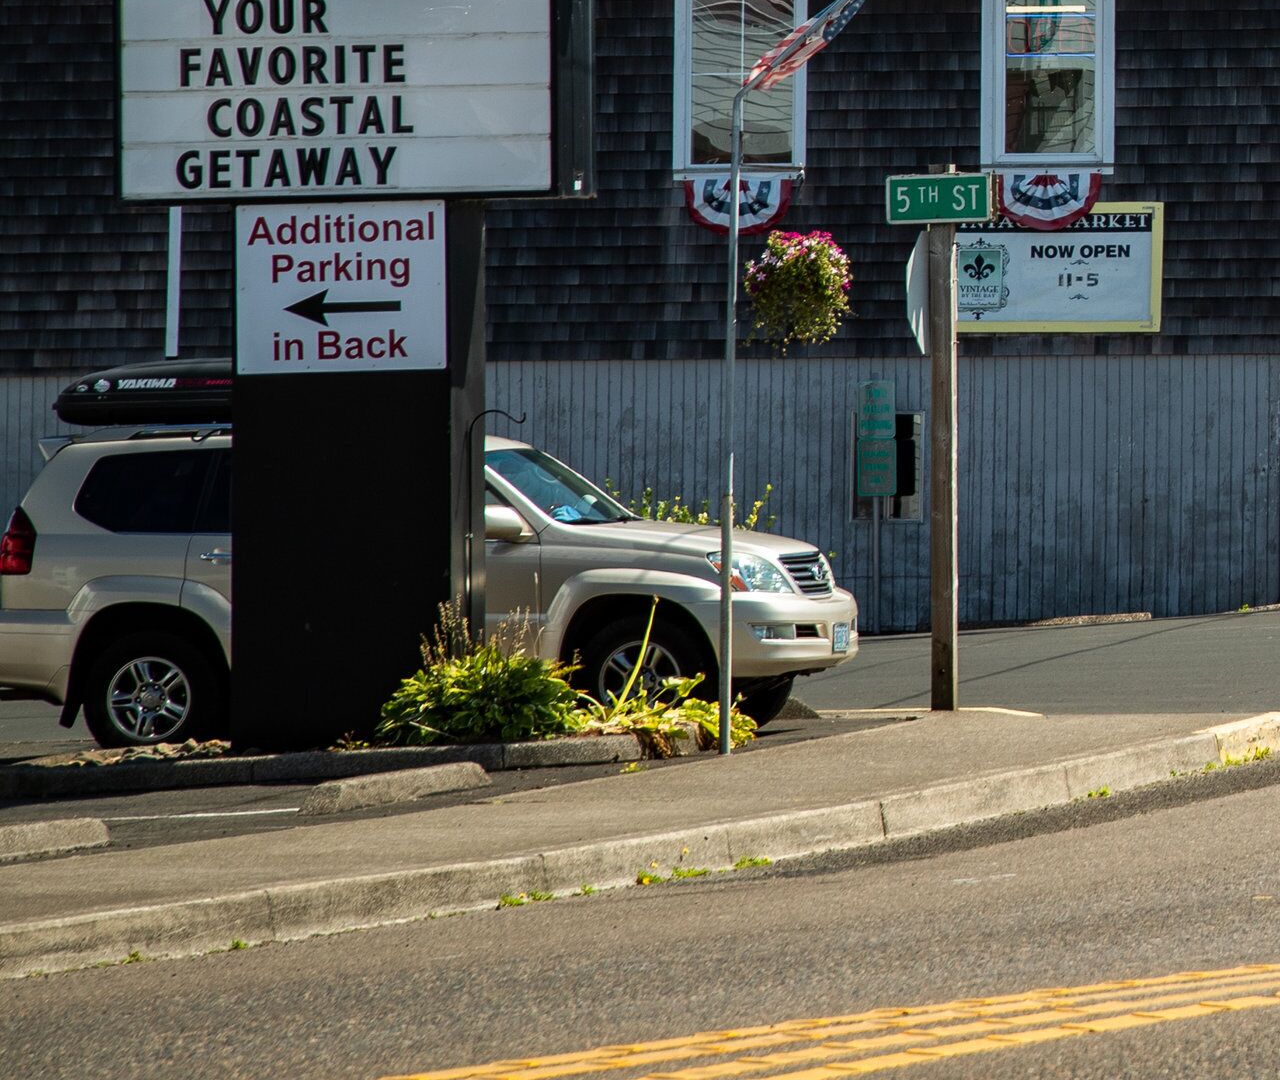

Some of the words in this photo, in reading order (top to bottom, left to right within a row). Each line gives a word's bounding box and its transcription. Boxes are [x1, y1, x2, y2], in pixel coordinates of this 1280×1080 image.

[179, 44, 406, 87] FAVORITE
[206, 95, 414, 138] COASTAL
[175, 146, 397, 189] GETAWAY
[952, 185, 980, 211] ST
[247, 211, 435, 246] Additional
[1031, 245, 1075, 258] NOW
[1080, 244, 1131, 258] OPEN
[271, 253, 411, 287] Parking
[960, 285, 999, 293] VINTAGE
[273, 331, 303, 361] in
[317, 329, 408, 360] Back
[118, 378, 177, 390] YAKIMA
